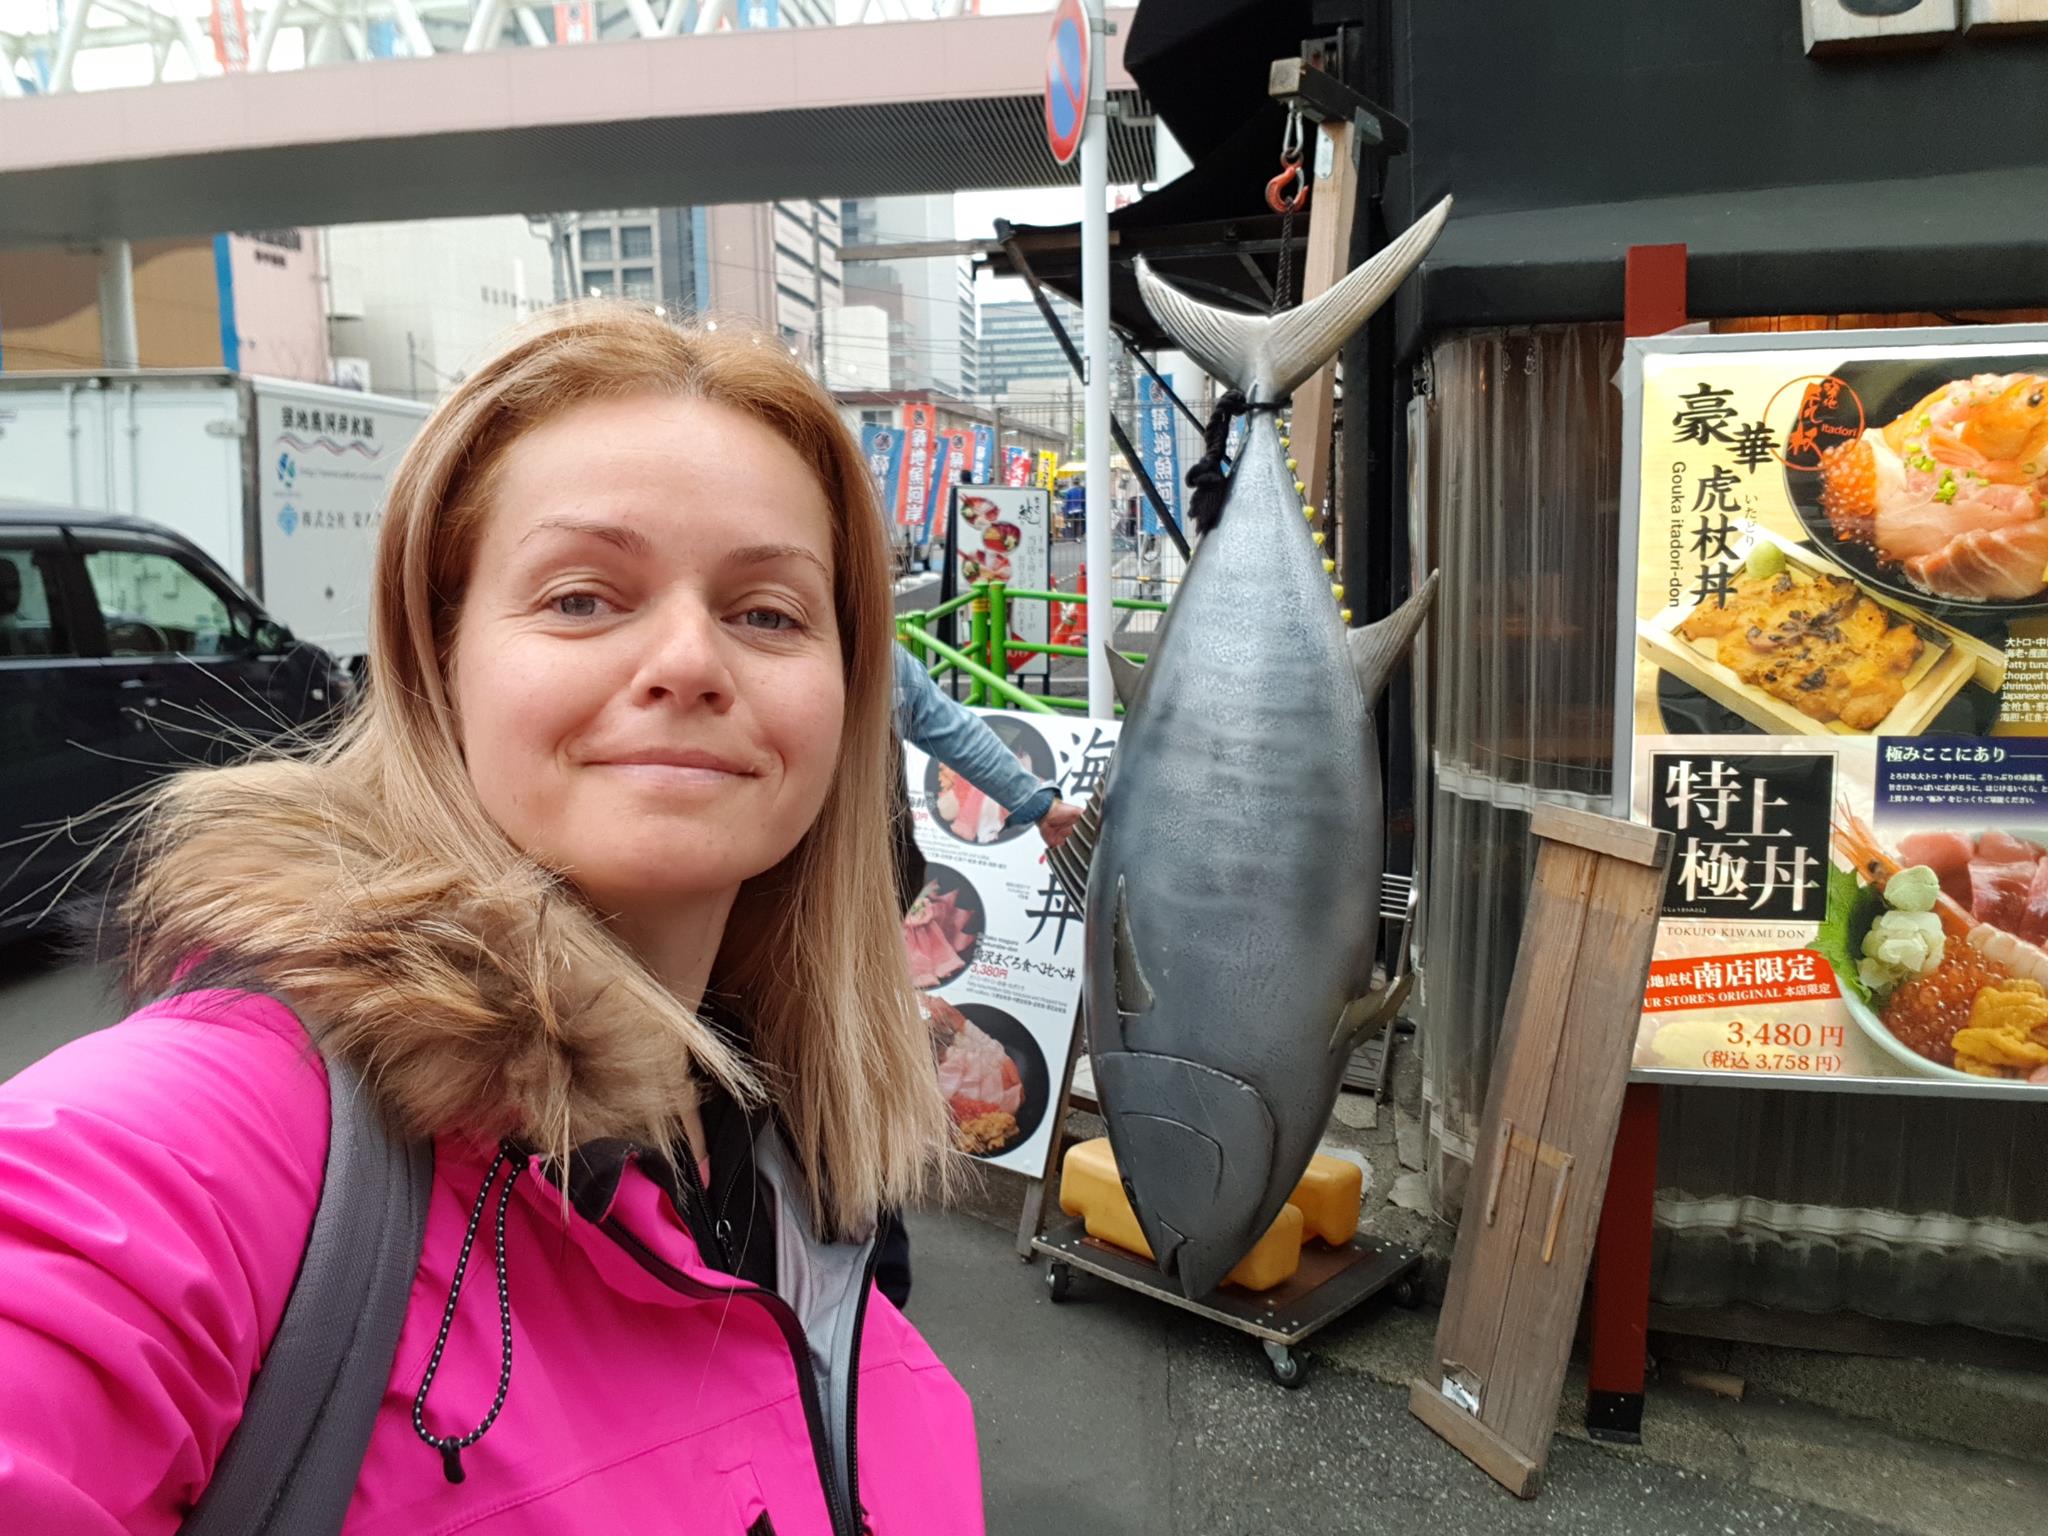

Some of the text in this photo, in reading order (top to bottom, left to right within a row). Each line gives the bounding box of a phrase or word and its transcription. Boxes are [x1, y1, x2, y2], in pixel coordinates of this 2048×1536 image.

[1672, 382, 1781, 609] 豪華 虎杖丼
[1669, 461, 1686, 607] Gouka itadori-don
[2002, 671, 2043, 681] chopped
[1885, 745, 2005, 763] 極みここにあり
[1665, 760, 1793, 837] 特上
[1678, 837, 1821, 912] 極丼
[1667, 926, 1806, 939] TOKUJO KIWAMI DON
[1643, 982, 1832, 1008] UR STORE'S ORIGINAL 本店限定
[1727, 1021, 1845, 1048] 3,480 円
[1755, 1054, 1810, 1071] 3,758
